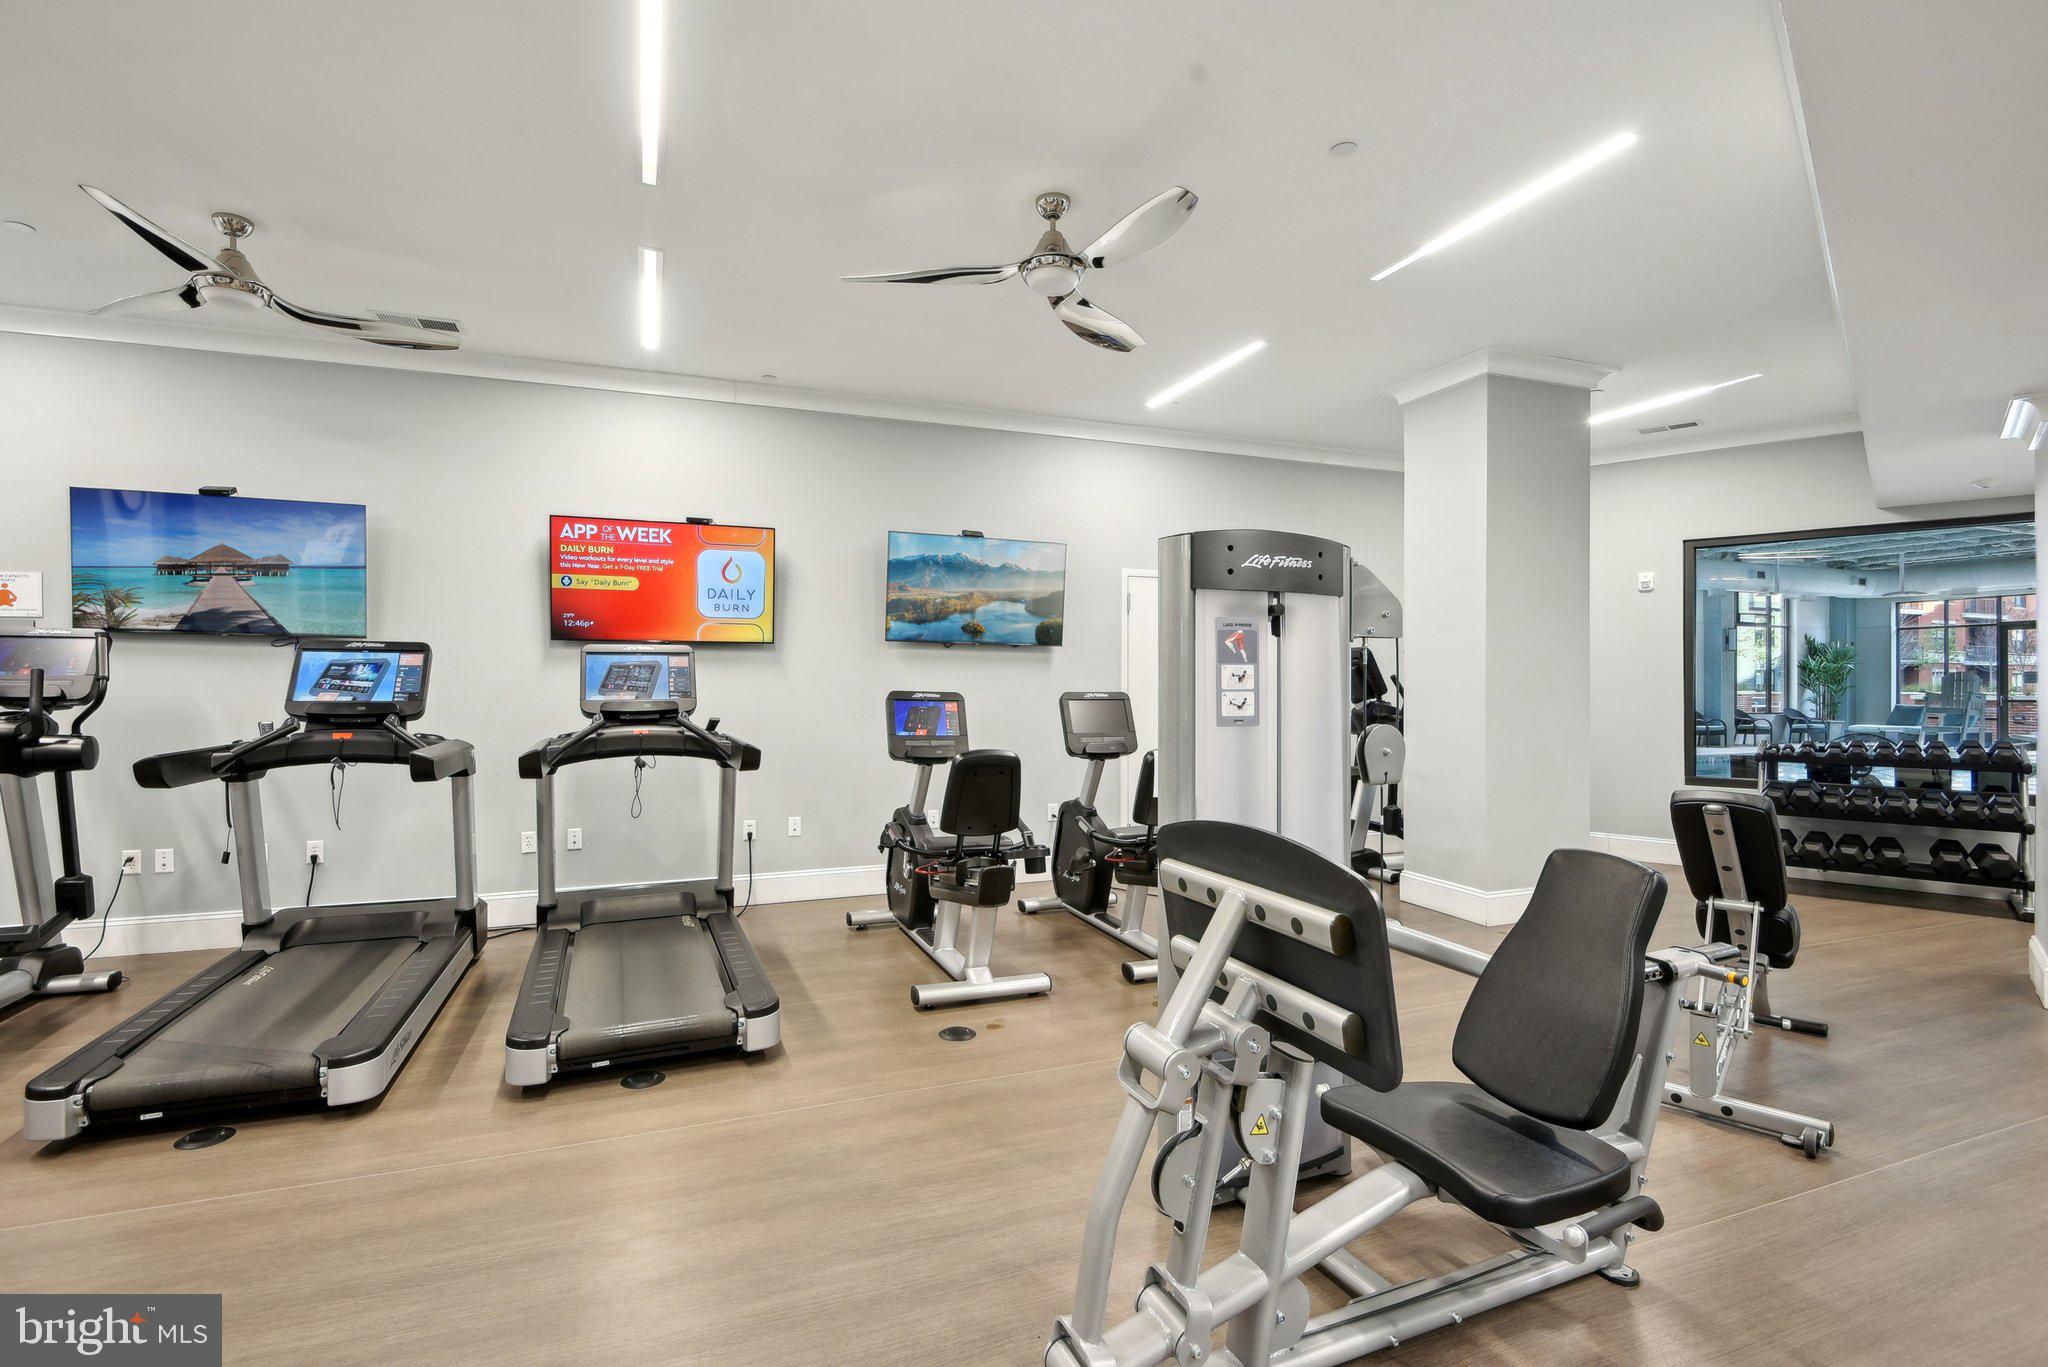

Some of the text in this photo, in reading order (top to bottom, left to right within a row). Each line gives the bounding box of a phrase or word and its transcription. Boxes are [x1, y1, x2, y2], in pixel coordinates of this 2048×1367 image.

[560, 523, 598, 539] APP
[601, 533, 616, 541] THE
[616, 526, 672, 544] WEEK
[560, 544, 614, 554] DAILY BURN
[1240, 554, 1313, 570] Life Fitness
[576, 578, 589, 586] Say
[707, 588, 756, 601] DAILY
[714, 603, 750, 612] BURN
